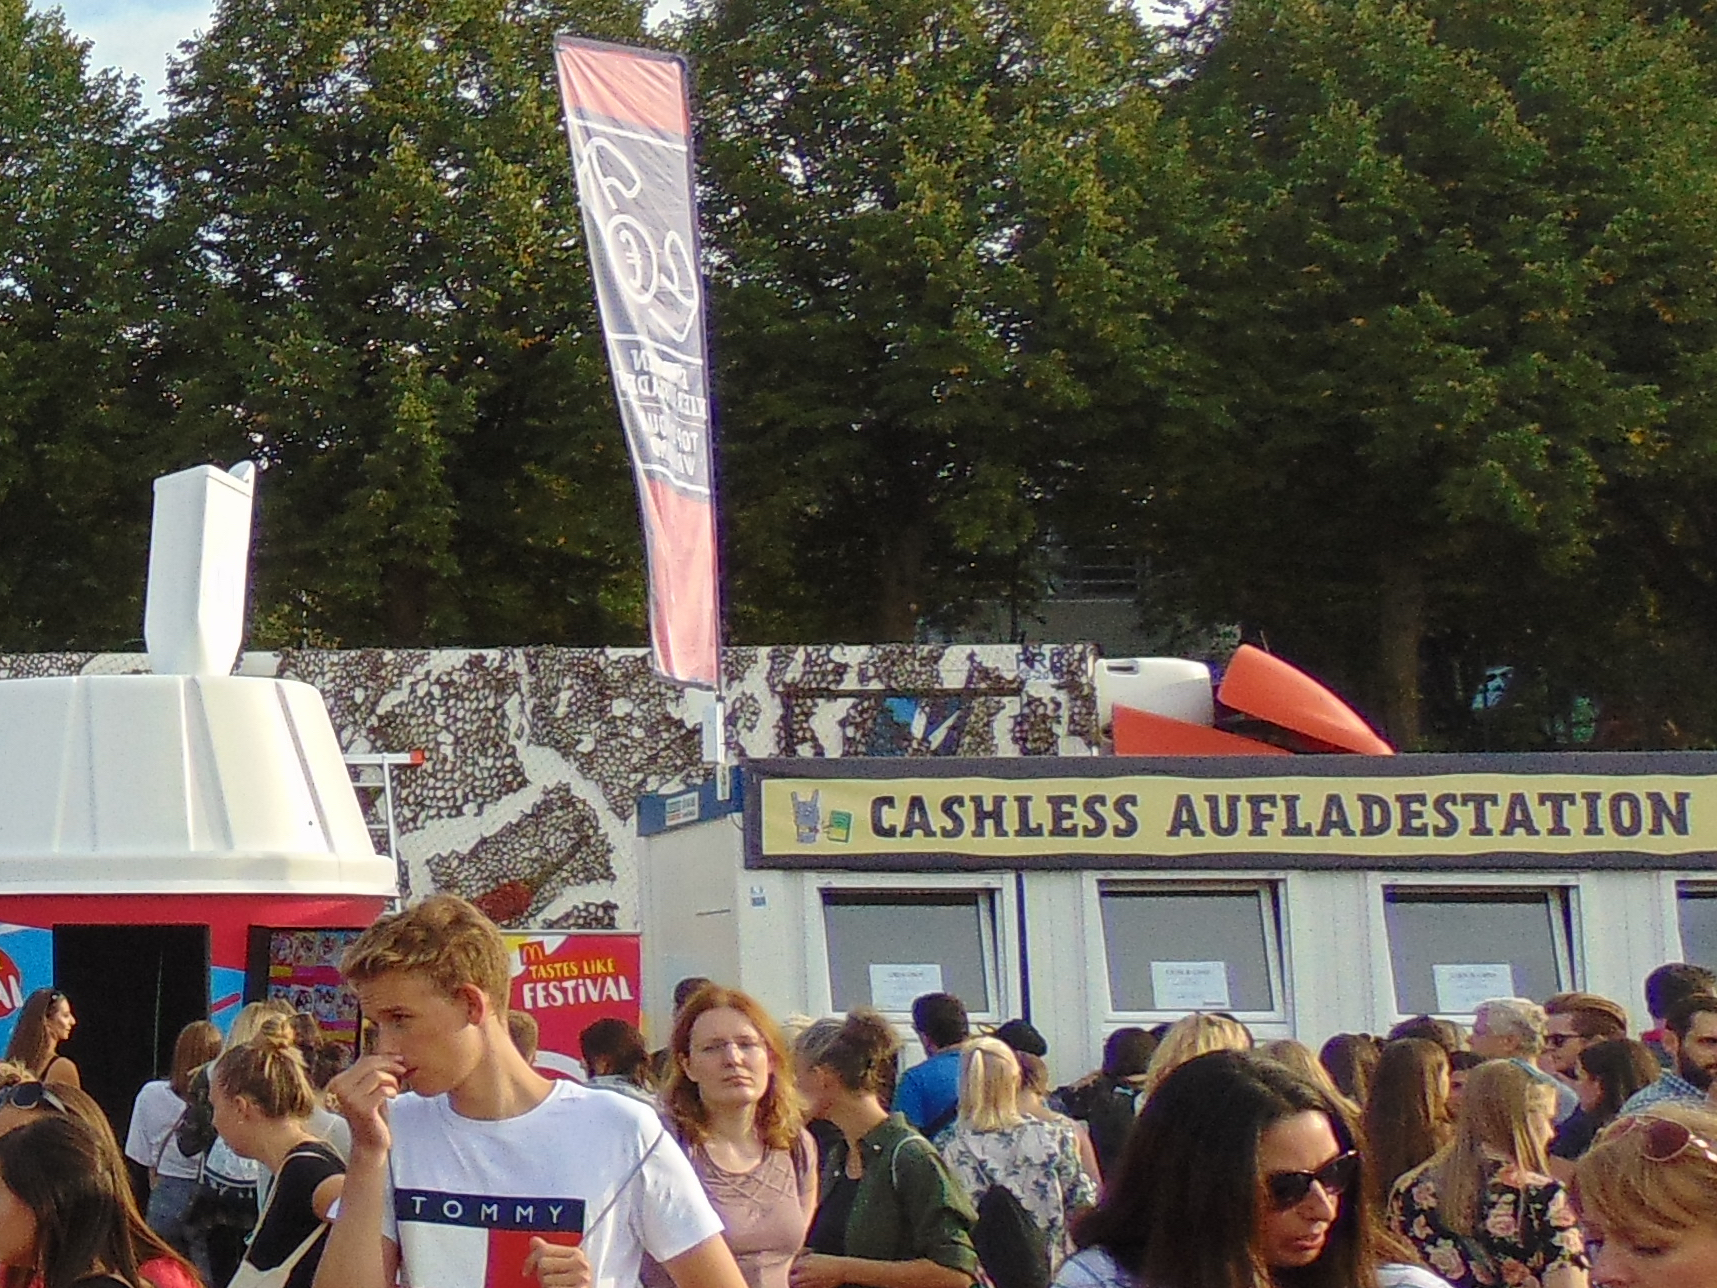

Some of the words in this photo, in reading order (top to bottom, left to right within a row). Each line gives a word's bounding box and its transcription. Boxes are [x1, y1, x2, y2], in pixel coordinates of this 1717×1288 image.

[870, 793, 1142, 840] CASHLESS
[1165, 789, 1692, 839] AUFLADESTATION
[528, 962, 579, 979] TASTES
[411, 1196, 563, 1224] TOMMY
